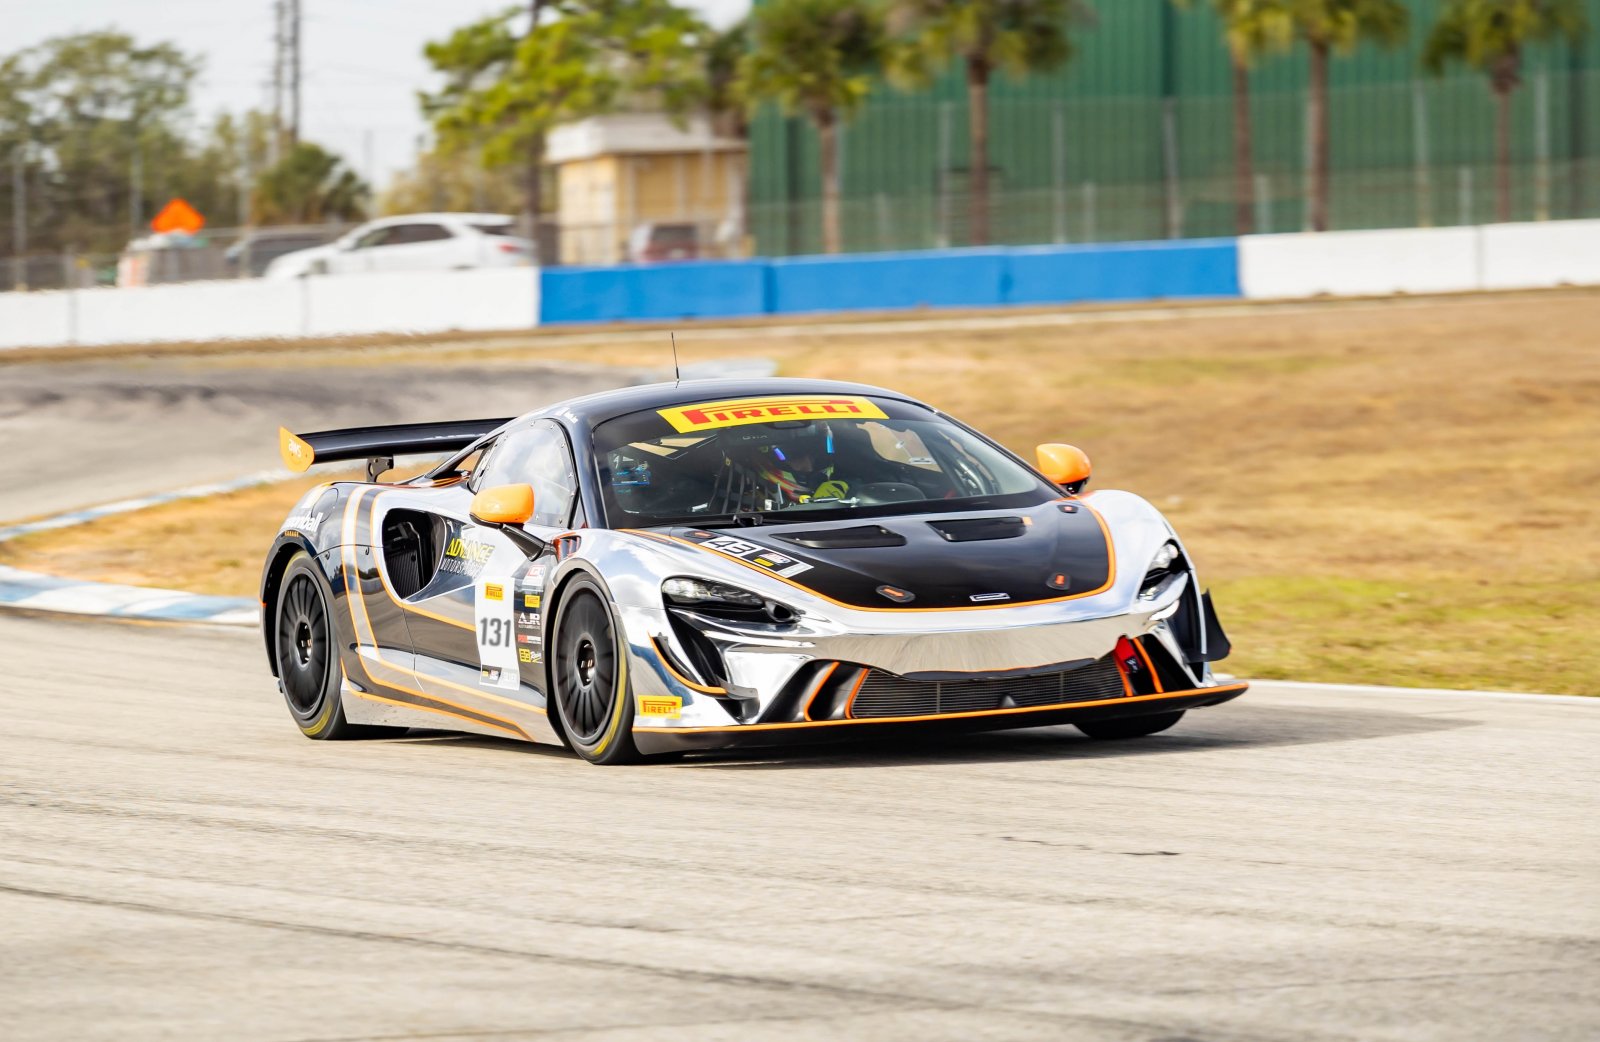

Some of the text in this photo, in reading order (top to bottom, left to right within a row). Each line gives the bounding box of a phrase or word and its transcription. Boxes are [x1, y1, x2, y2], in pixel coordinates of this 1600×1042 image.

[682, 400, 862, 425] PIRELLI
[446, 537, 496, 565] ADVANCE
[480, 617, 511, 648] 131
[643, 700, 677, 714] PIRELLI
